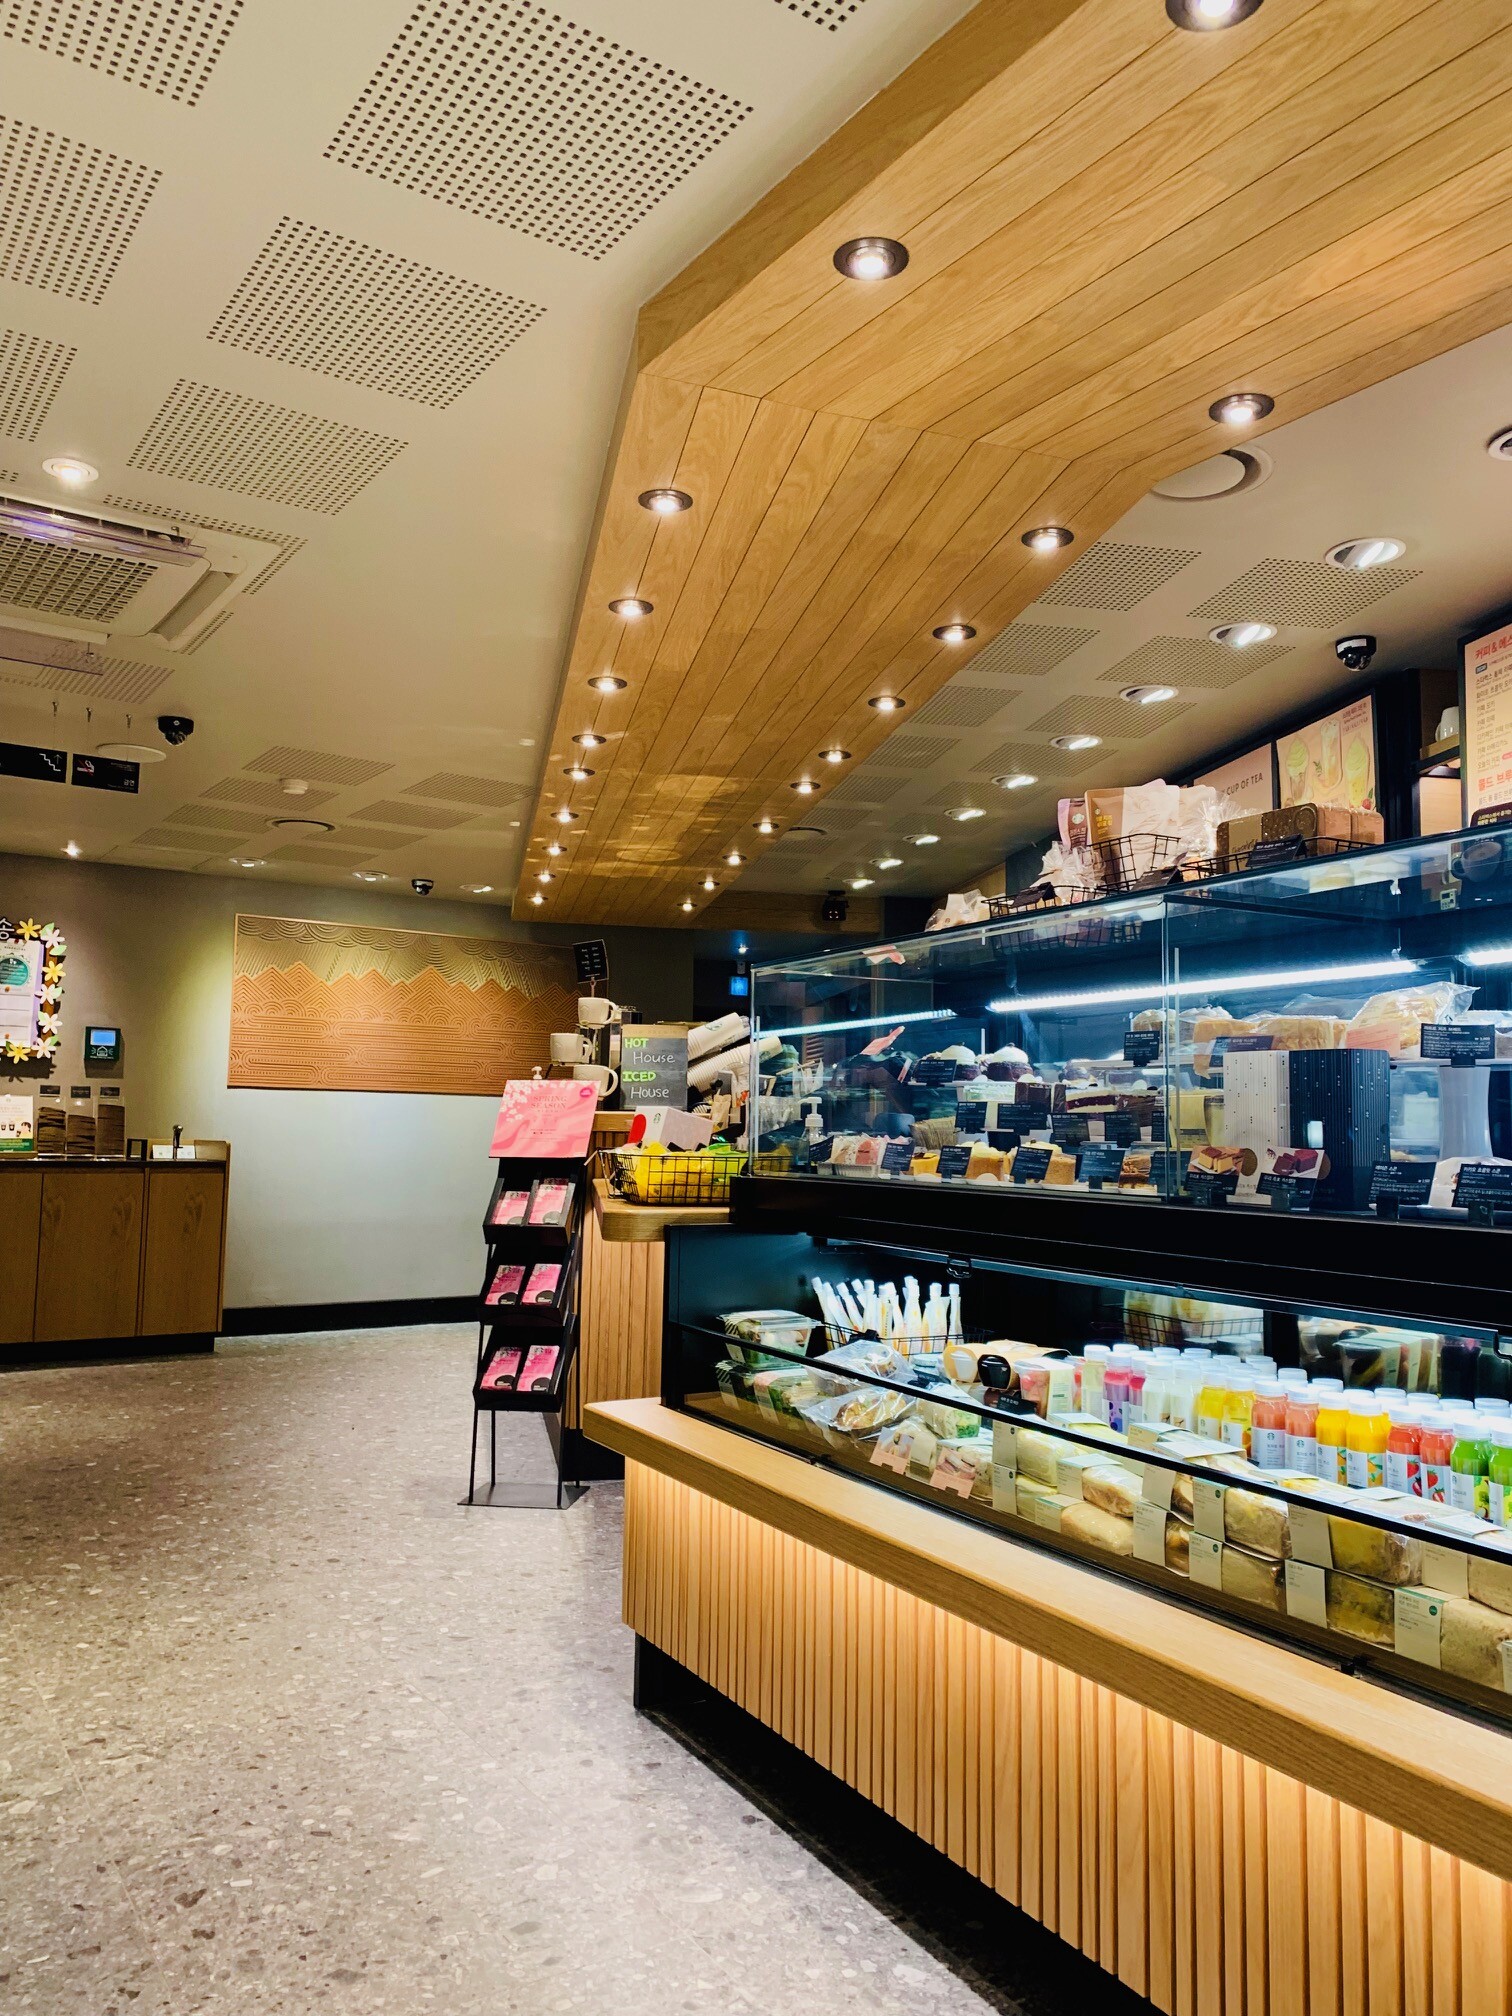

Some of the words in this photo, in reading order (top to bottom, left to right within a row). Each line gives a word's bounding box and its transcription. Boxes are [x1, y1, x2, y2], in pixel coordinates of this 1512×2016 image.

[1226, 783, 1239, 795] CUP
[1240, 779, 1249, 789] OF
[1251, 773, 1263, 784] TEA
[624, 1037, 650, 1049] HOT
[633, 1051, 676, 1065] House
[621, 1070, 657, 1082] ICED
[630, 1086, 670, 1099] House
